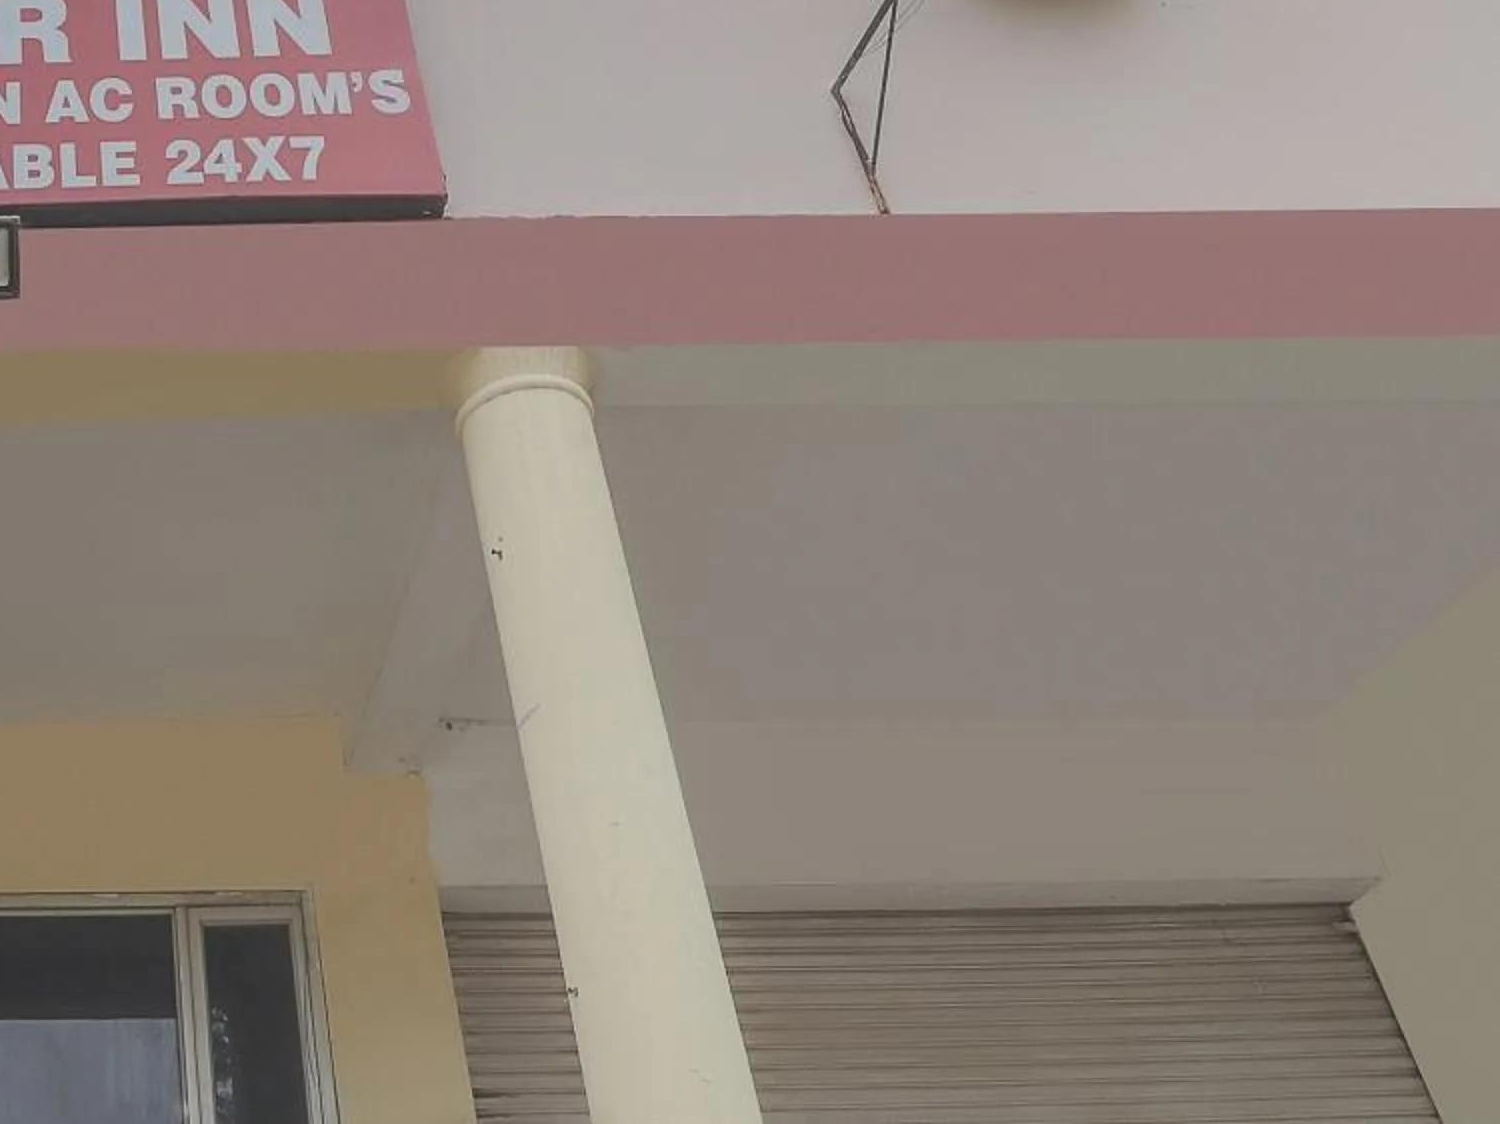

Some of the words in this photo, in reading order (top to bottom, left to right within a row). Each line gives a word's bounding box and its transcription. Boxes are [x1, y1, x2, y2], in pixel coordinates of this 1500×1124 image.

[45, 78, 134, 123] AC
[156, 69, 412, 119] ROOM'S
[165, 135, 327, 186] 24X7
